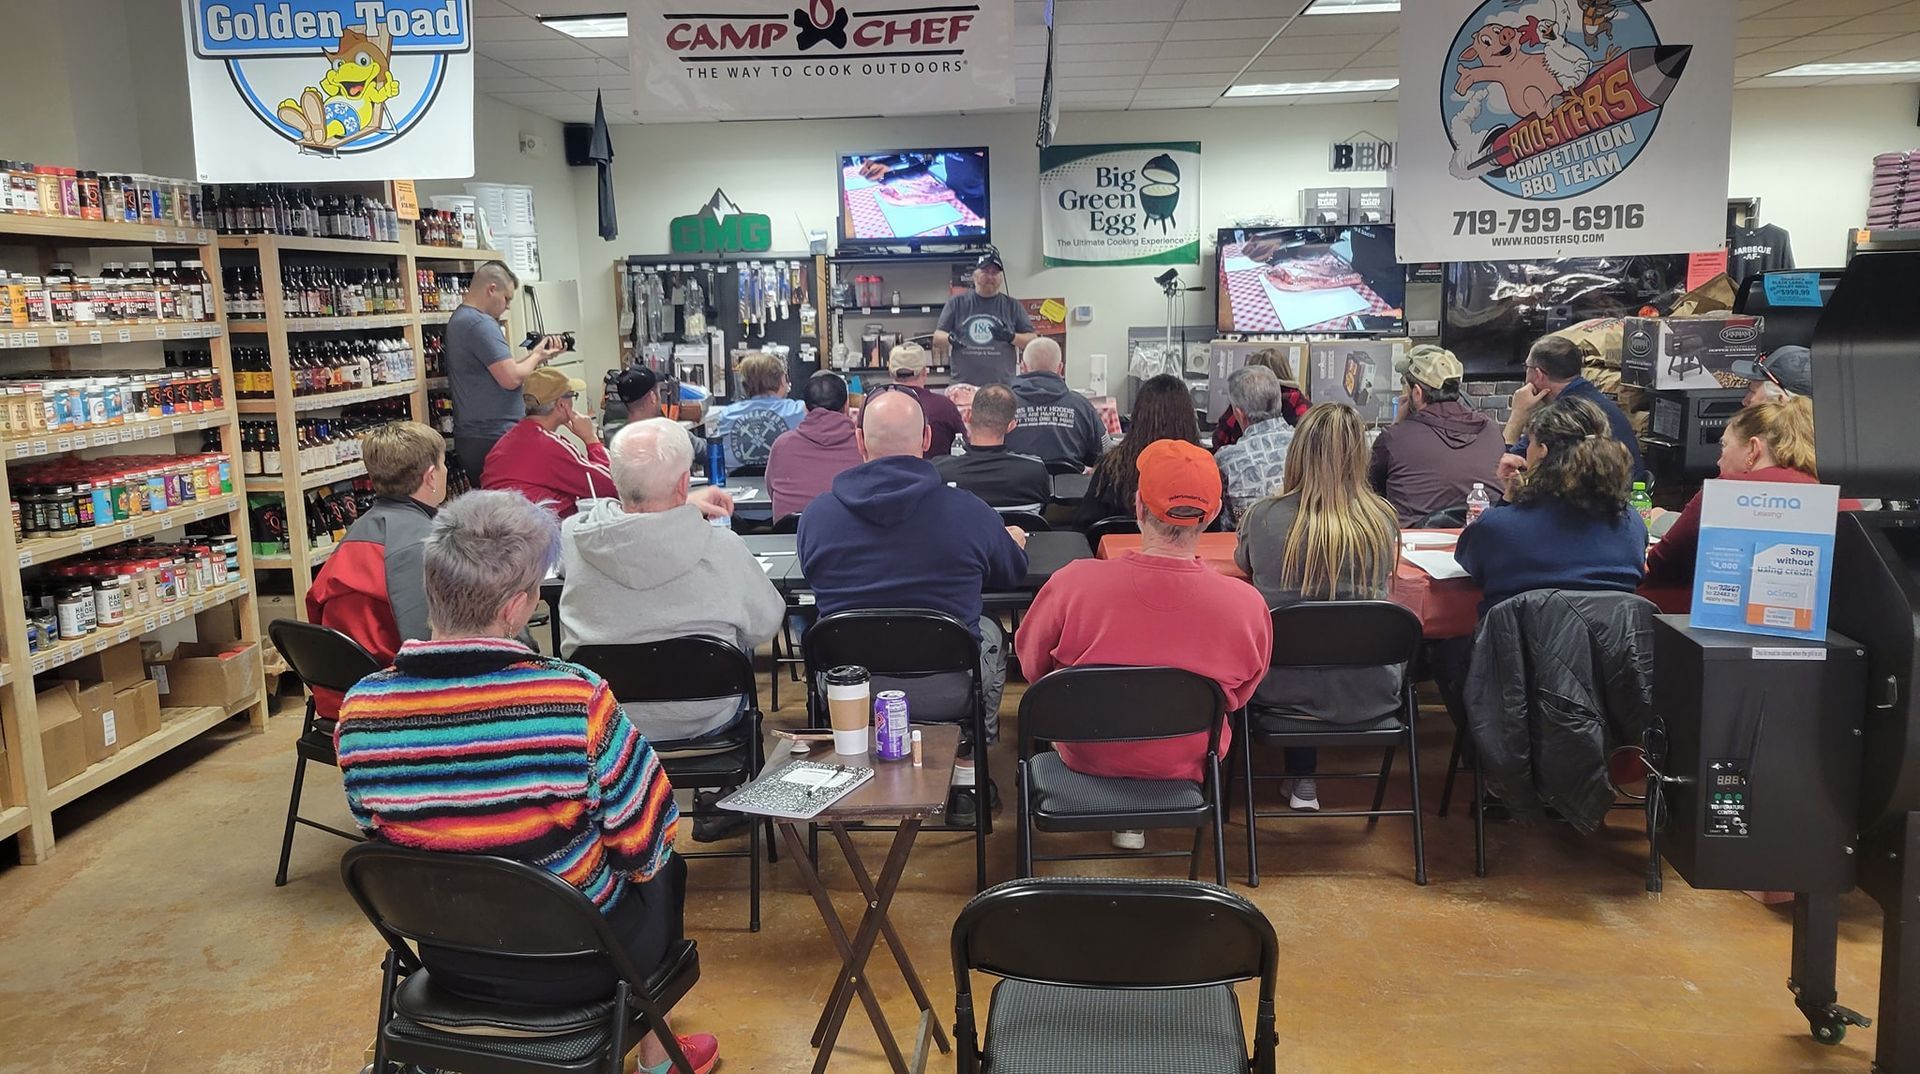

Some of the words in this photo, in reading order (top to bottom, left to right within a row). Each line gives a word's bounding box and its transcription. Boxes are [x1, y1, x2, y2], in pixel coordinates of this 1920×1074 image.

[206, 3, 344, 42] Golden
[355, 0, 460, 37] Toad
[666, 23, 789, 50] CAMP
[852, 14, 975, 47] CHEF
[686, 67, 718, 79] THE
[726, 66, 762, 78] WAY
[771, 66, 793, 77] TO
[803, 64, 852, 77] COOK
[1508, 69, 1639, 160] ROOSTER'S
[1333, 143, 1392, 169] BBQ
[1505, 121, 1637, 184] COMPETITION
[1096, 167, 1136, 192] Big
[1520, 172, 1557, 199] BBQ
[1559, 152, 1623, 187] TEAM
[1058, 189, 1136, 211] Green
[1090, 211, 1136, 236] Egg
[1452, 203, 1645, 236] 719-799-6916
[670, 213, 771, 254] GMG
[1057, 239, 1072, 247] The
[1073, 238, 1105, 247] Ultimate
[1106, 237, 1139, 247] Cooking
[1141, 237, 1184, 247] Experience
[1491, 233, 1605, 247] WWW.ROOSTERSQ.COM
[1737, 493, 1801, 510] acima
[1777, 557, 1813, 566] without
[1790, 548, 1814, 557] Shop
[1757, 565, 1783, 575] using
[1785, 568, 1813, 576] credit
